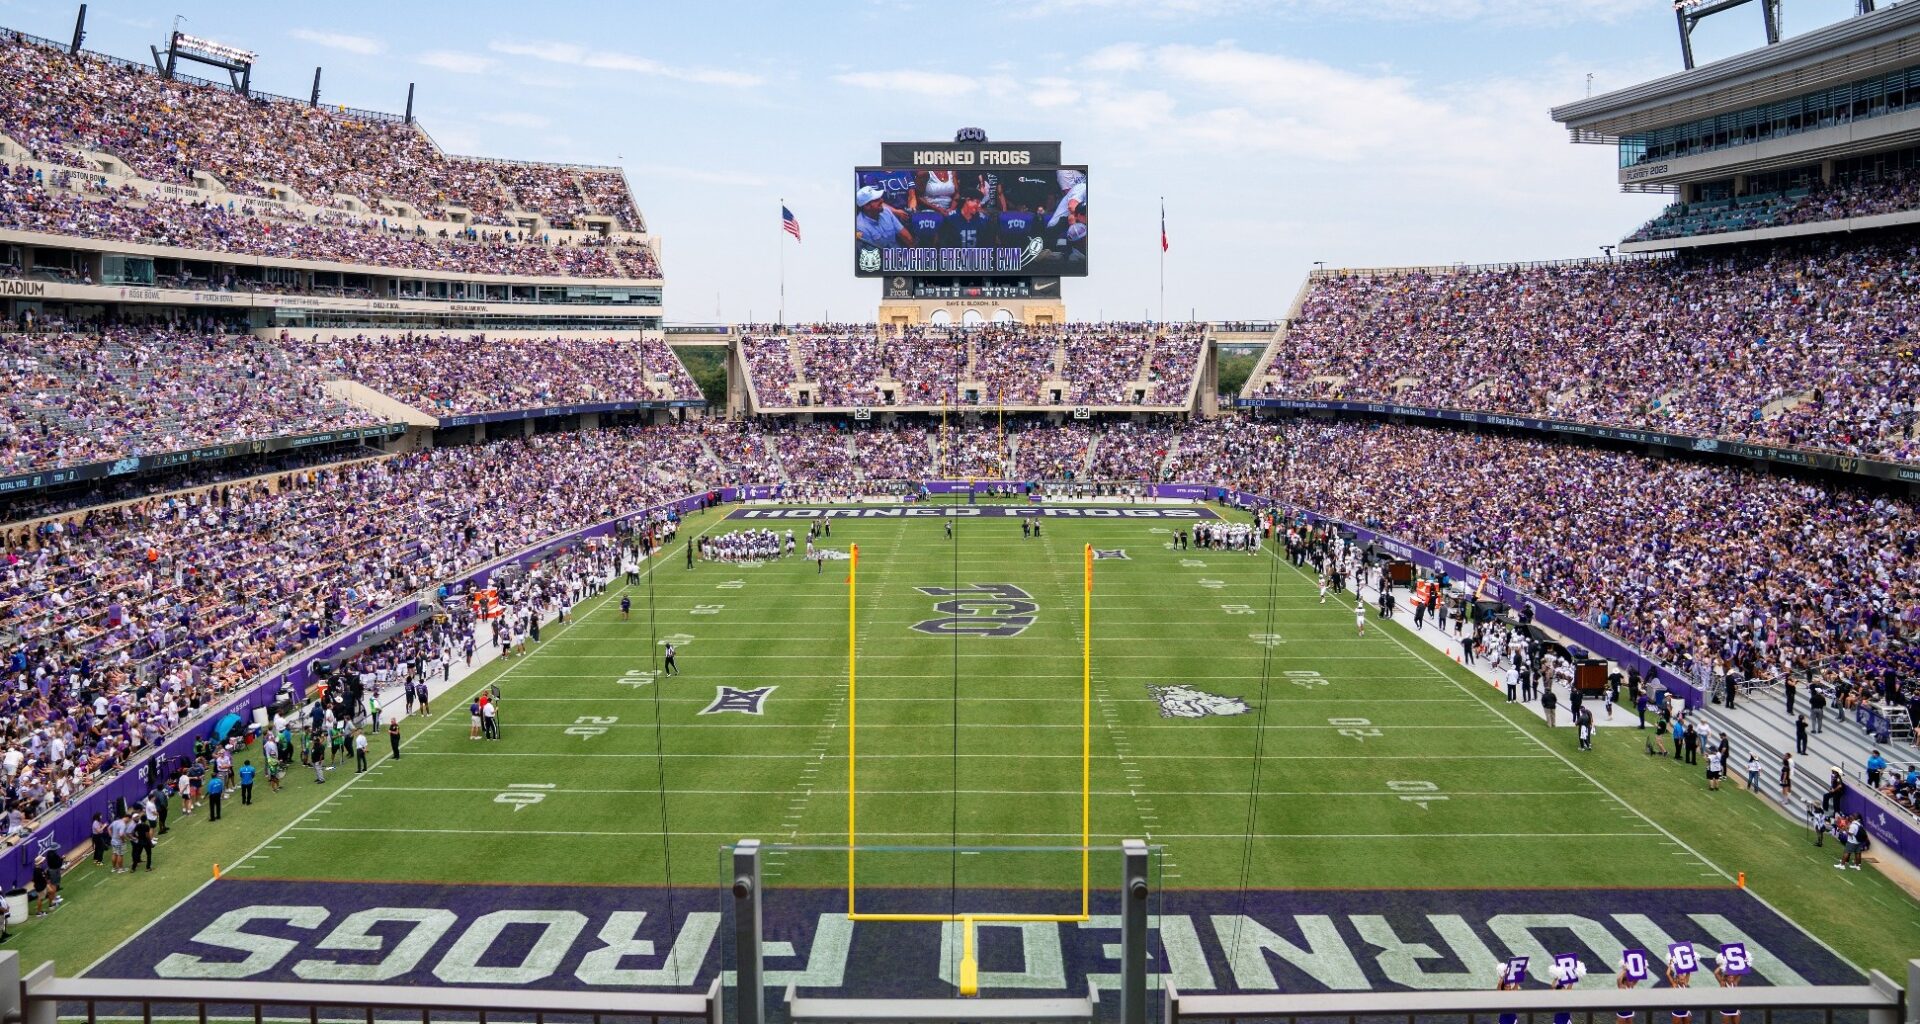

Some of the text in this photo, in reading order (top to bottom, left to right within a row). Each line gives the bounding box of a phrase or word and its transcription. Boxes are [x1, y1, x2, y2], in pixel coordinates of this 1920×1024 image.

[957, 127, 985, 141] TCU
[913, 151, 1031, 165] HORNED FROGS
[1650, 165, 1668, 175] 2023
[919, 220, 936, 229] TCU
[1007, 220, 1025, 229] TCU
[960, 230, 977, 247] 15
[883, 247, 1021, 272] BLEACHER CREATURE CAM
[857, 409, 869, 418] 25
[1076, 408, 1089, 417] 25
[16, 479, 28, 488] YDS
[744, 508, 1200, 519] HORNED FROGS
[908, 583, 1040, 638] TCU
[616, 669, 662, 685] 30
[1282, 670, 1330, 686] 30
[564, 715, 619, 736] 20
[1327, 717, 1384, 736] 20
[494, 782, 556, 804] 10
[1386, 780, 1450, 801] 10
[153, 904, 1812, 990] HORNED FROGS
[1508, 945, 1747, 981] F R O G S
